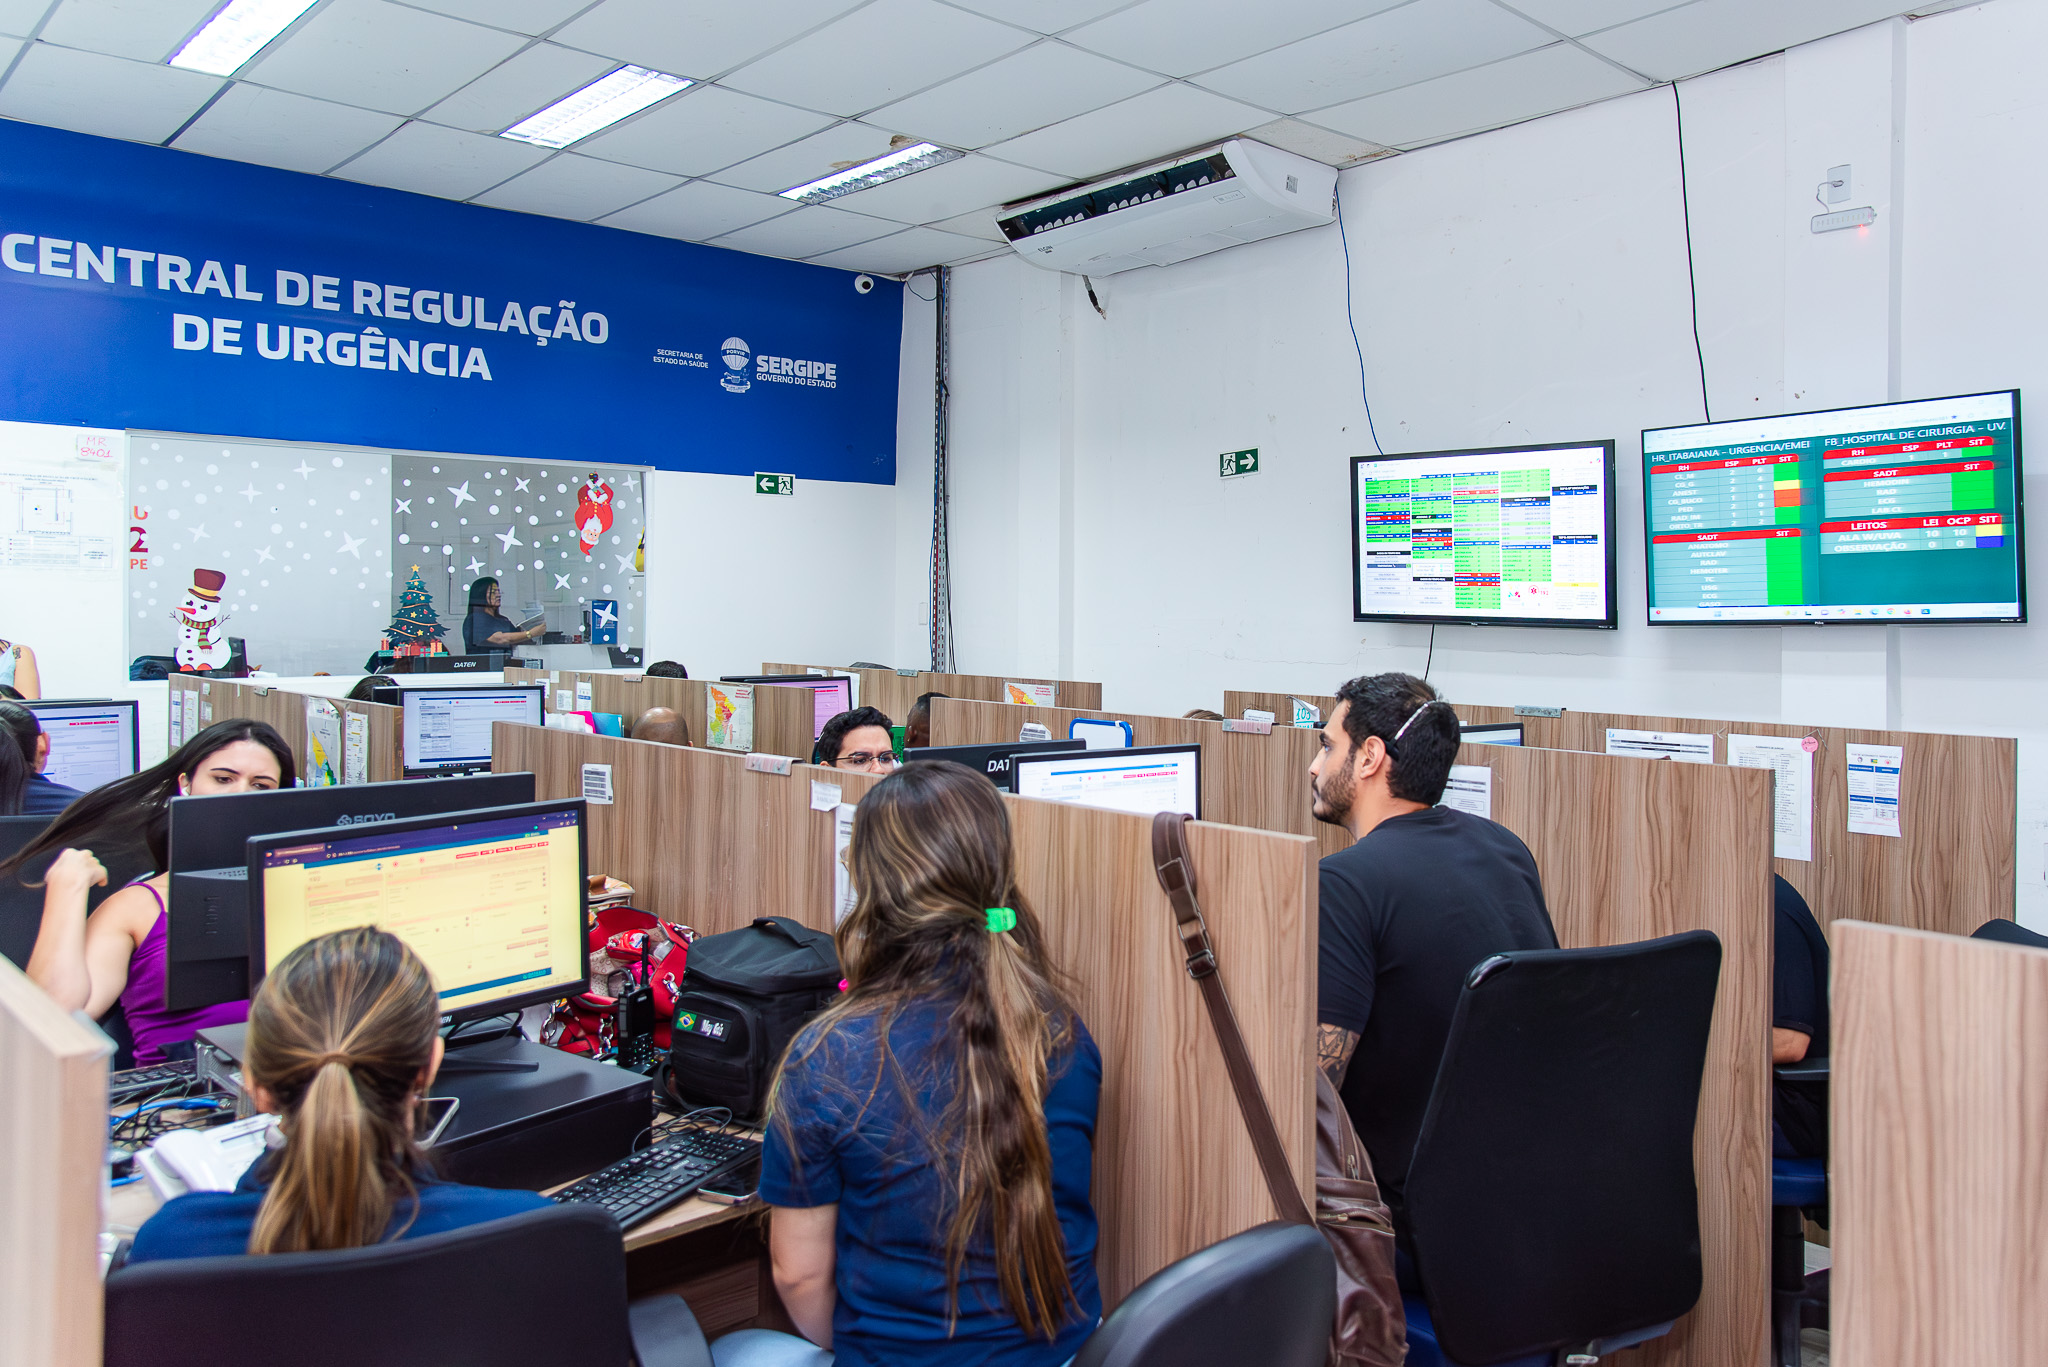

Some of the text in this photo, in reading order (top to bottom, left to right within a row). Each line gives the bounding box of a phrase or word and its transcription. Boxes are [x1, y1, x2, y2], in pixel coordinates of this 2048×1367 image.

[1, 233, 609, 346] CENTRAL DE REGULAÇÃO
[173, 313, 493, 381] DE URGÊNCIA
[657, 349, 694, 360] SECRETARIA
[653, 356, 678, 365] ESTADO
[689, 359, 709, 369] SAÚDE
[756, 354, 837, 381] SERGIPE
[756, 372, 837, 389] GOVERNO DO ESTADO
[86, 436, 108, 447] MR
[1825, 433, 1897, 447] FB_HOSPITAL
[1899, 430, 1915, 439] DE
[1917, 425, 1975, 438] CIRURGIA
[1968, 438, 1985, 446] SIT
[80, 447, 114, 458] 8401
[1652, 449, 1720, 462] HR_ITABAIANA
[1851, 515, 1998, 530] LEITOS LEI OCP SIT
[1838, 533, 1861, 542] ALA
[1925, 530, 1940, 538] 10
[1952, 528, 1967, 536] 10
[1834, 542, 1907, 553] OBSERVAÇÃO
[987, 758, 1010, 772] DAT
